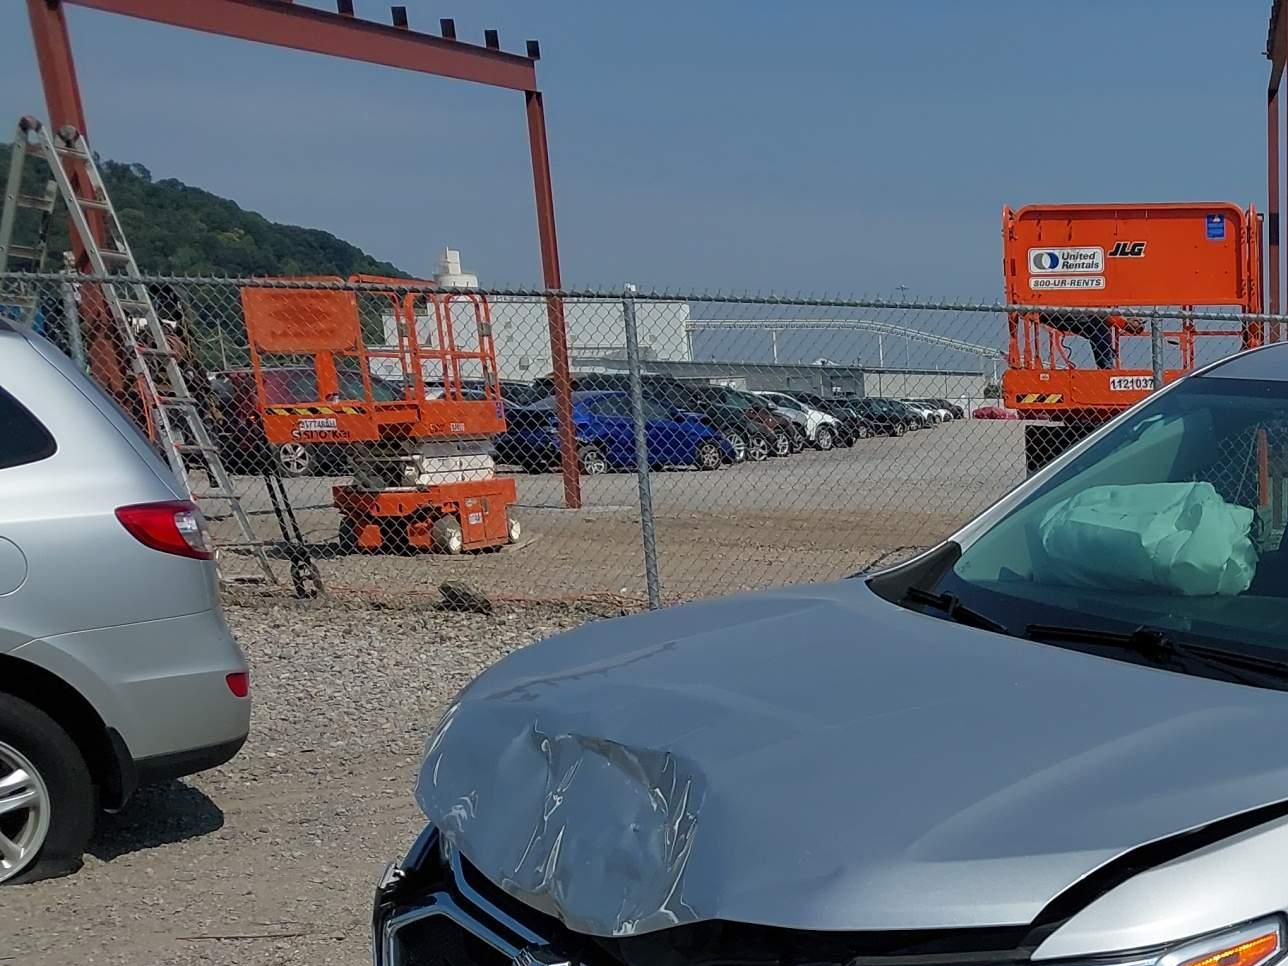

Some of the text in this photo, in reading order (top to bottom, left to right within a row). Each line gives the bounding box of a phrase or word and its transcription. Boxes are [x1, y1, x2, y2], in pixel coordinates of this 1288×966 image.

[1109, 241, 1146, 257] JLG
[1061, 251, 1096, 261] United
[1061, 259, 1100, 270] Rentals
[1033, 278, 1102, 288] 800-UR-RENTS
